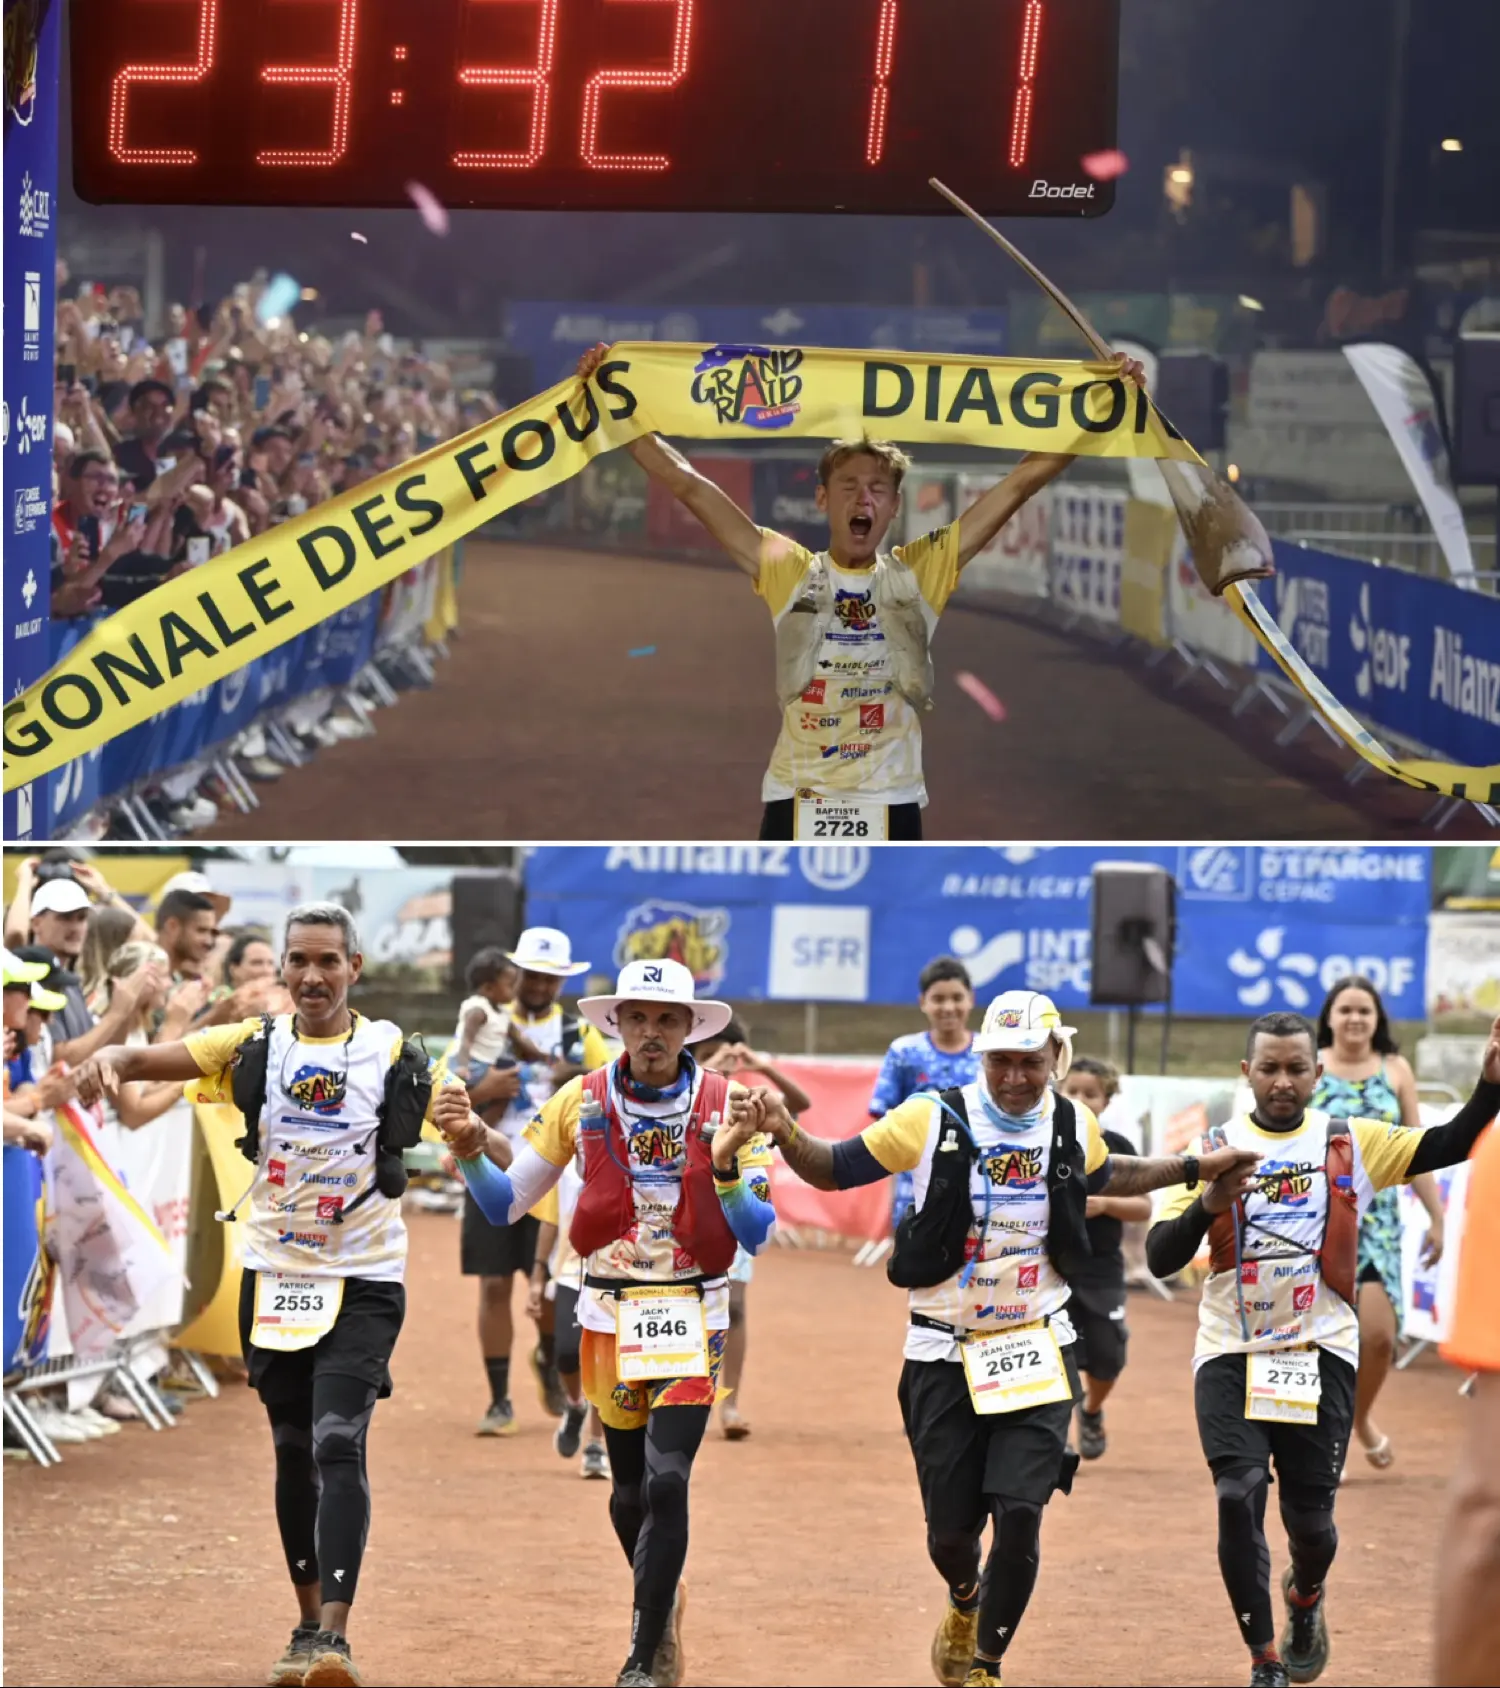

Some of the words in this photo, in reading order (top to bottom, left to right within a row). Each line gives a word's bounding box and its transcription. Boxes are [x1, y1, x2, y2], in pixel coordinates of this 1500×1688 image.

[1028, 179, 1096, 199] Bodet
[3, 557, 295, 771] GONALE
[296, 474, 445, 592] DES
[454, 360, 638, 501] FOUS
[815, 808, 860, 816] BAPTISTE
[813, 820, 869, 837] 2728
[792, 934, 862, 968] SFR
[300, 1172, 342, 1185] Allianz
[279, 1282, 316, 1290] PATRICK
[273, 1295, 325, 1312] 2553
[640, 1308, 671, 1316] JACKY
[996, 1304, 1027, 1313] INTER
[996, 1311, 1026, 1320] SPORT
[633, 1320, 688, 1339] 1846
[979, 1346, 1003, 1358] JEAN
[1004, 1339, 1033, 1351] DENIS
[986, 1350, 1042, 1377] 2672
[1270, 1358, 1311, 1368] YANNICK
[1267, 1369, 1320, 1387] 2737
